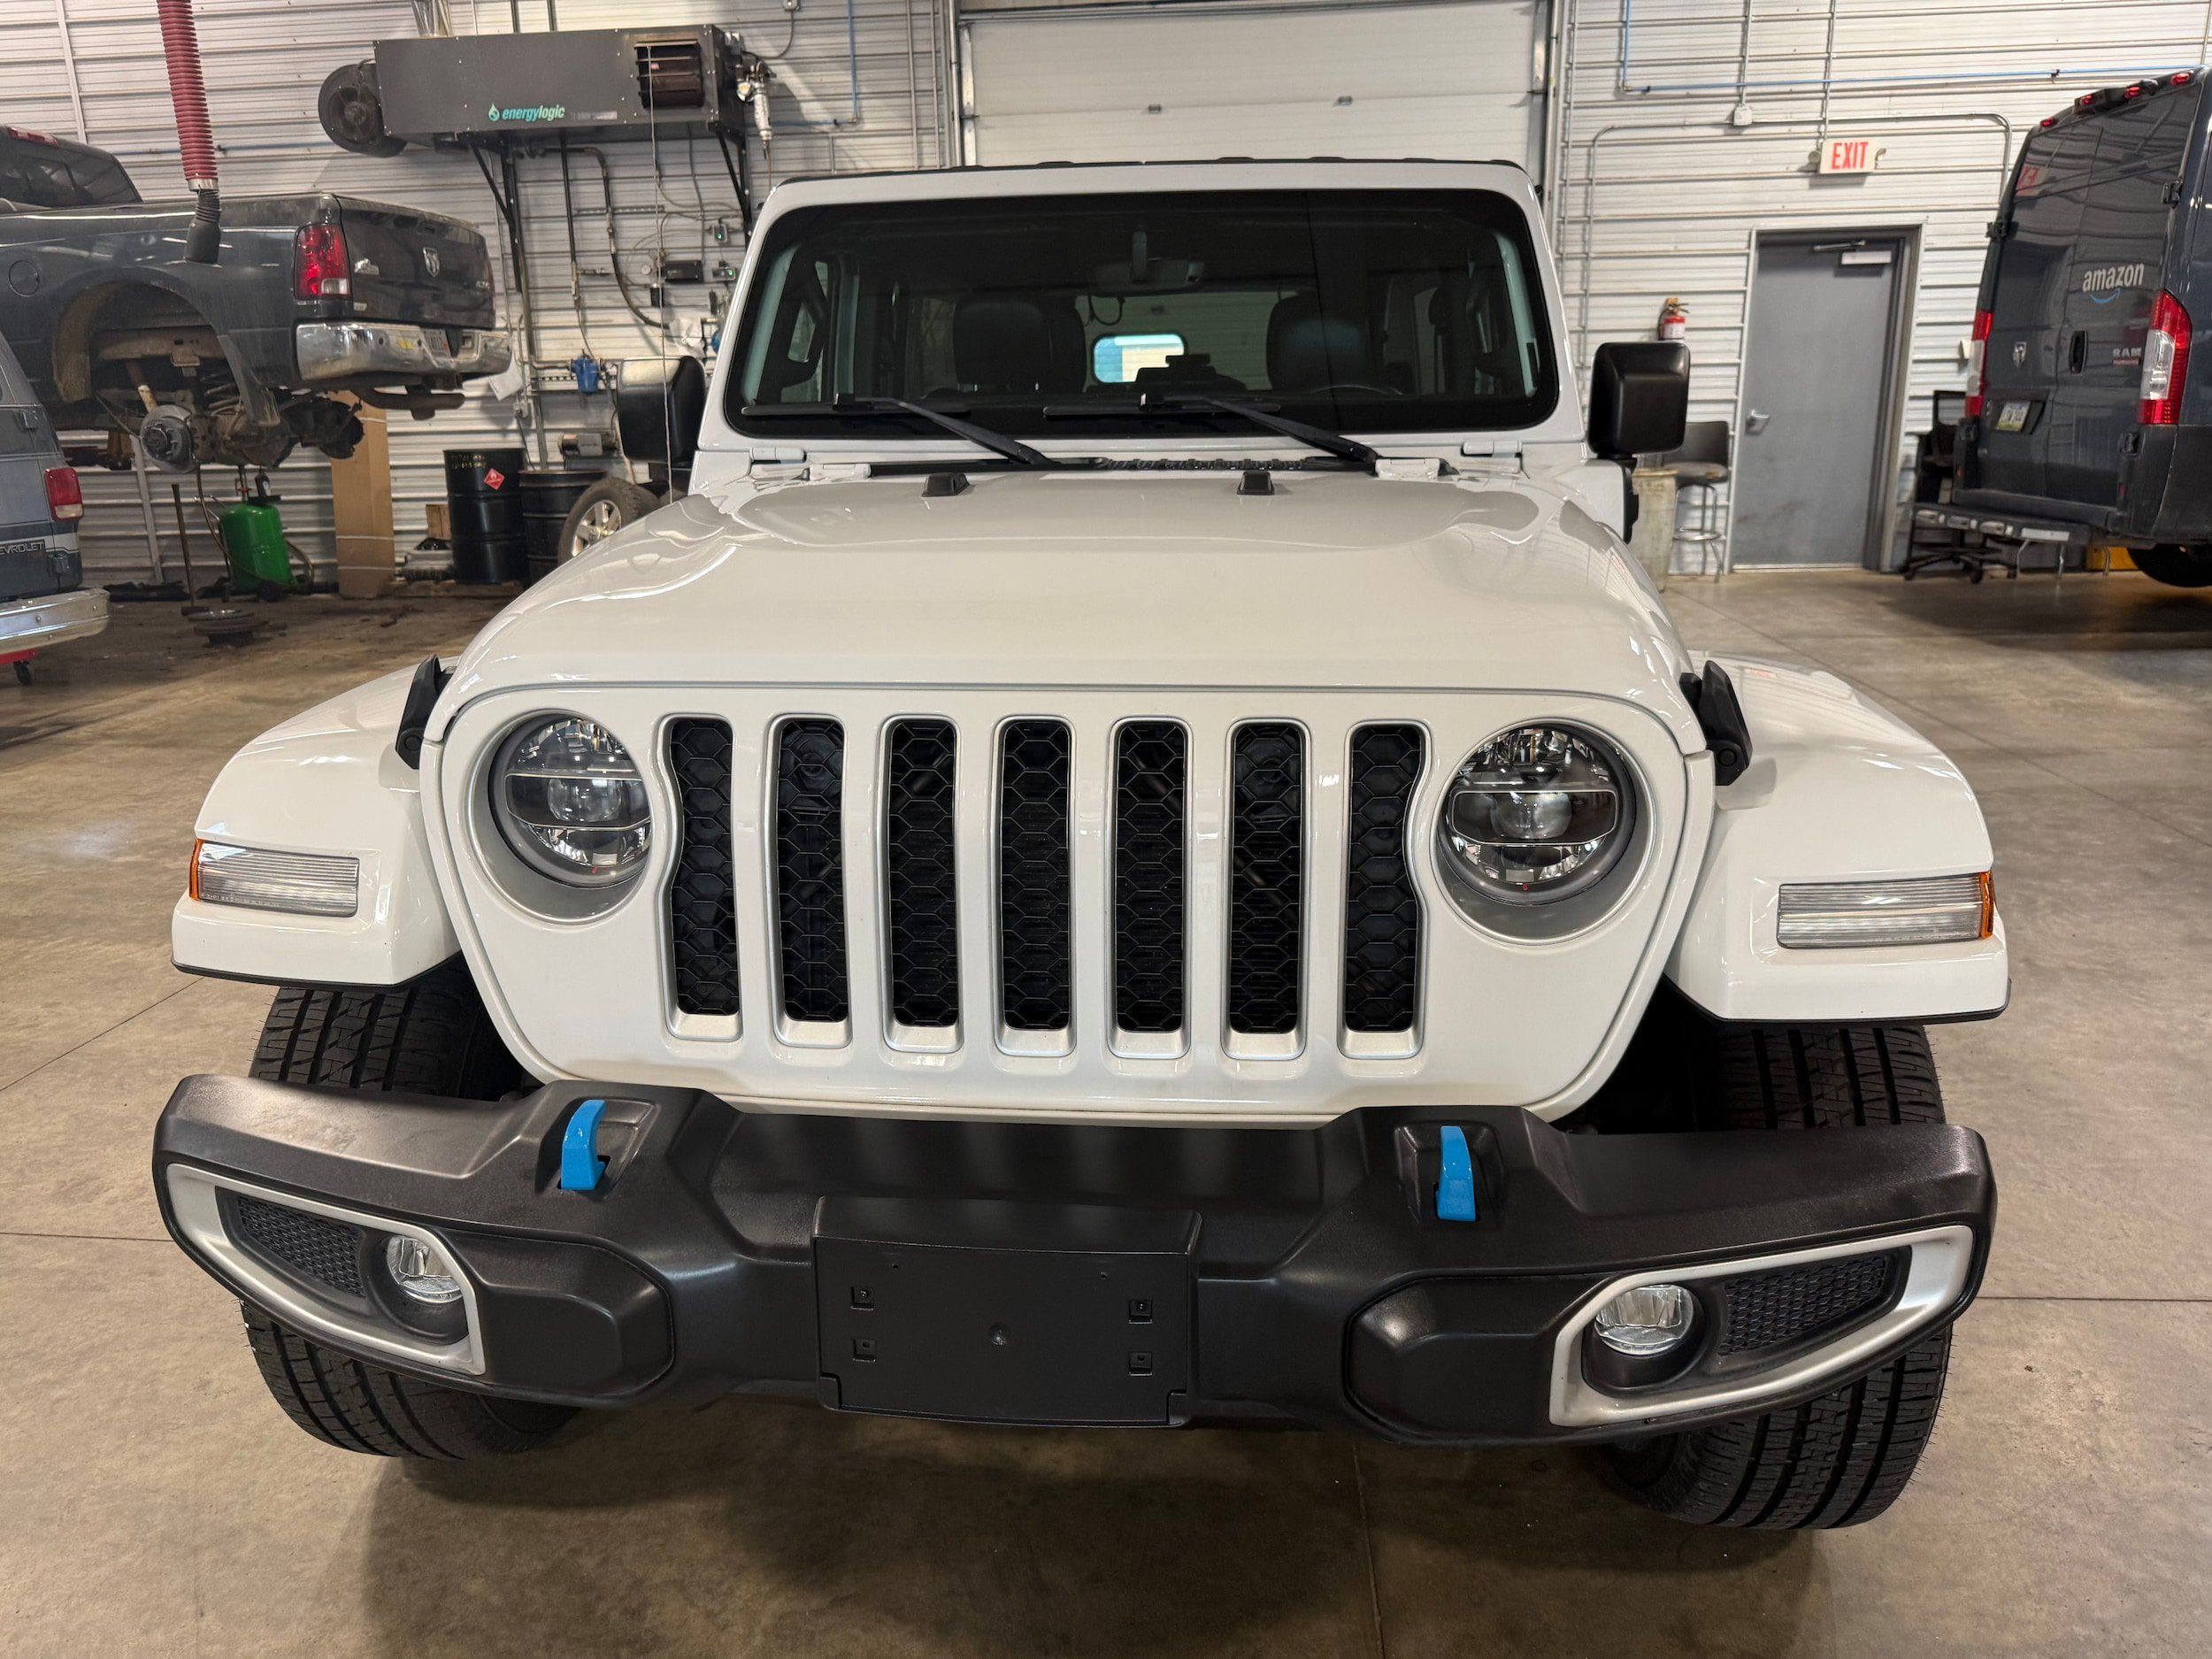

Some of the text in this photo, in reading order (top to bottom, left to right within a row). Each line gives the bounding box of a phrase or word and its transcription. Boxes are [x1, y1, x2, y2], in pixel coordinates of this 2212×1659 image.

[502, 104, 565, 122] energylogic
[1831, 142, 1869, 170] EXIT
[2082, 264, 2145, 292] amazon
[2112, 348, 2142, 357] RAM
